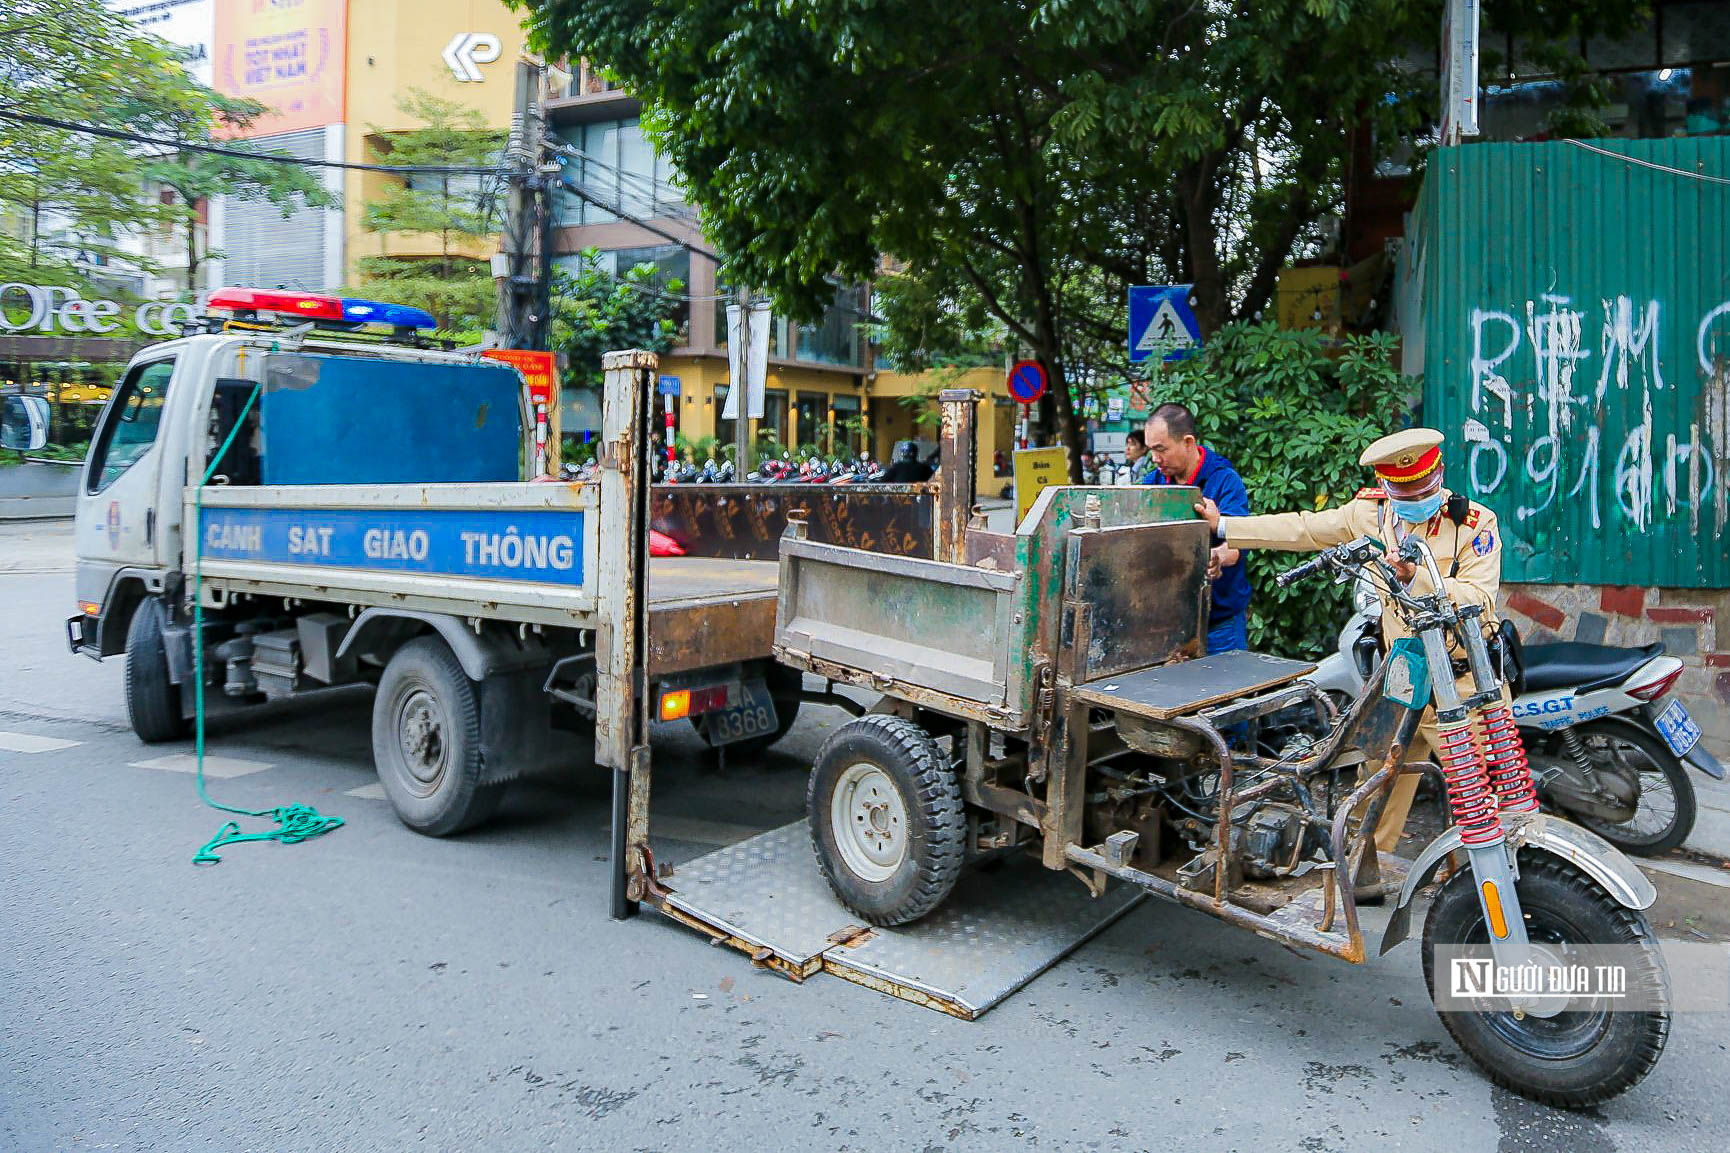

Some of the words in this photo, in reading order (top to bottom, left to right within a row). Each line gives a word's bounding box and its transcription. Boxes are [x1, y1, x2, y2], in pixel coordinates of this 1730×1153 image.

[288, 526, 335, 556] SAT
[363, 529, 430, 561] GIAO
[460, 525, 574, 570] THÔNG
[1577, 704, 1611, 721] POLICE
